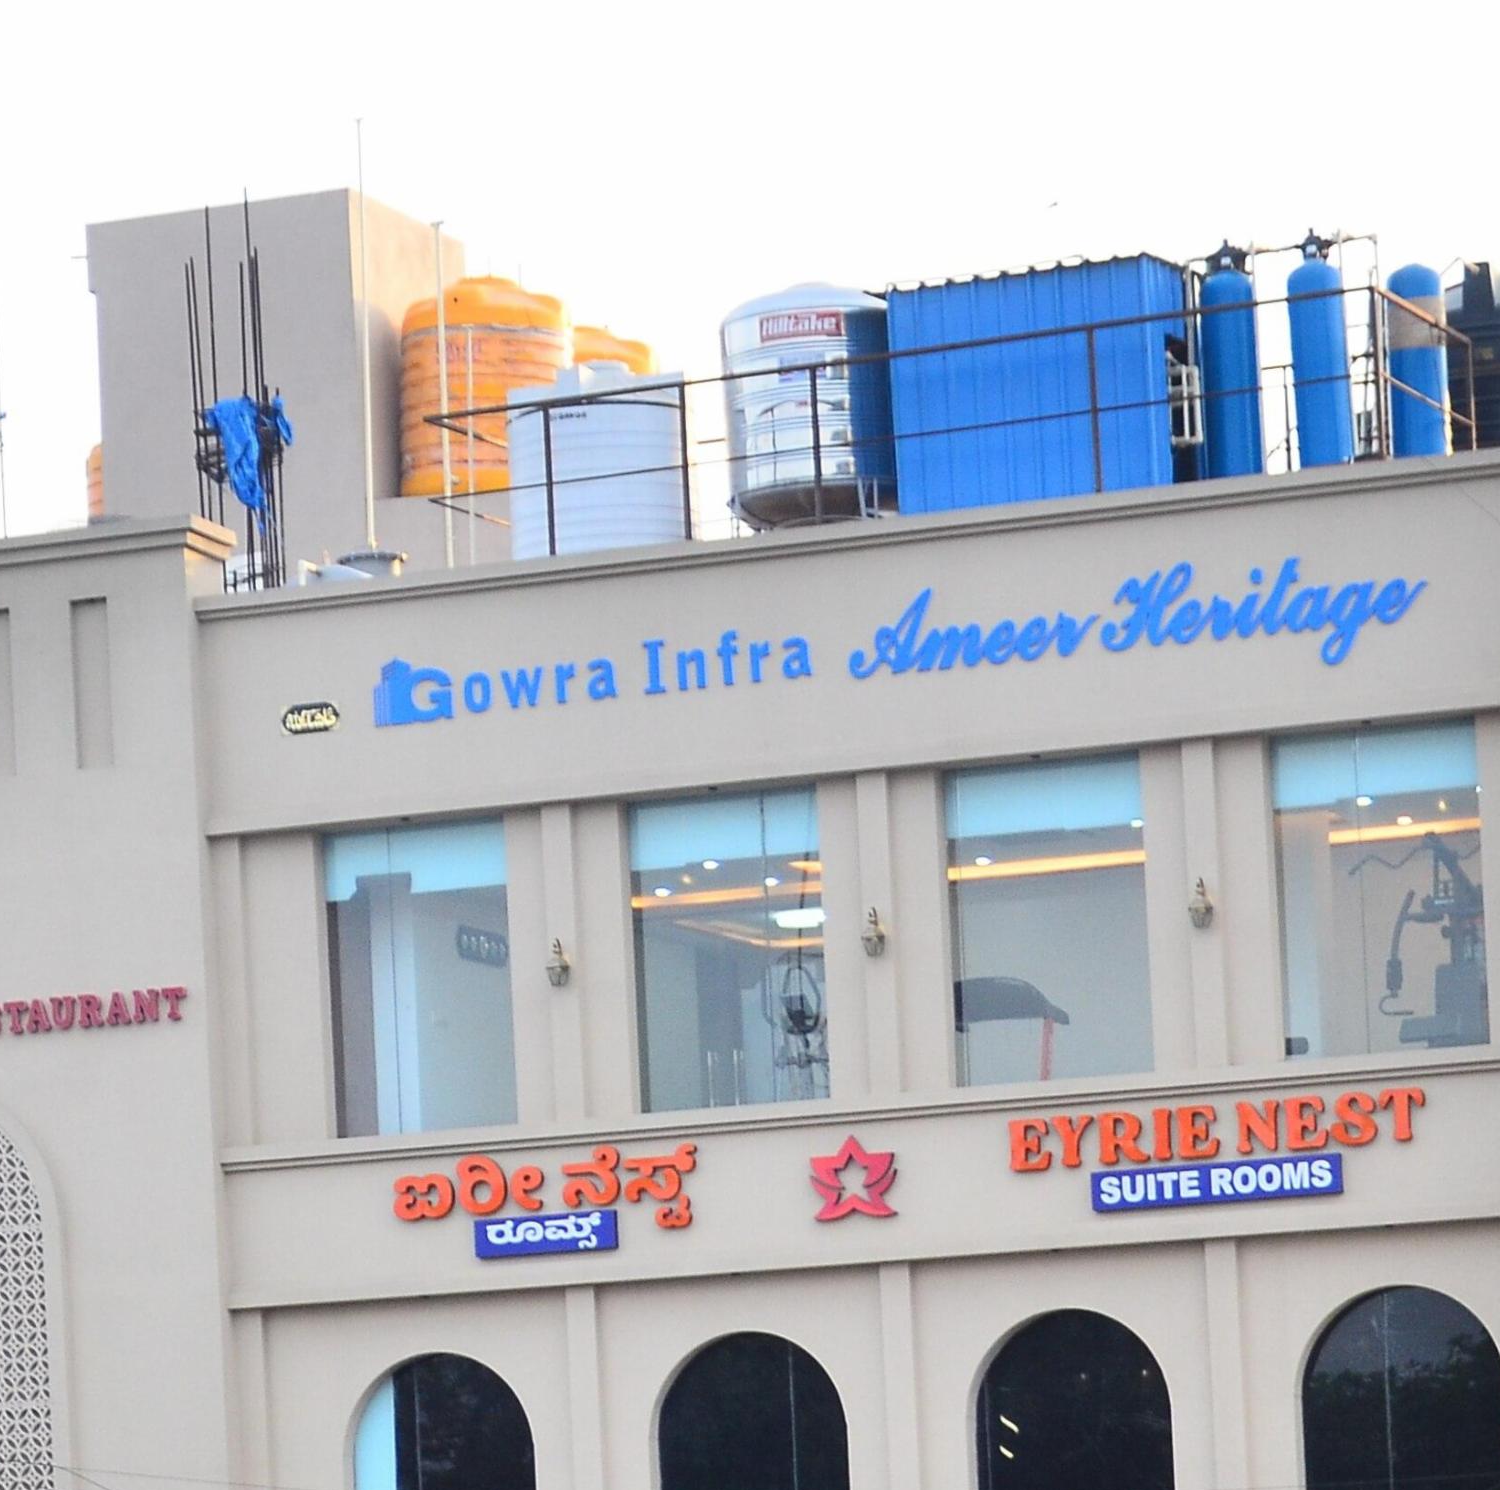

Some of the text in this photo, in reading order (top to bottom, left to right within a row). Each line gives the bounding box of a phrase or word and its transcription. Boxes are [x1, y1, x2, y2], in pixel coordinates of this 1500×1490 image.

[374, 557, 1427, 727] Gowra Infra Ameer Heritage
[1007, 1087, 1426, 1172] EYRIE NEST
[1099, 1158, 1334, 1204] SUITE ROOMS
